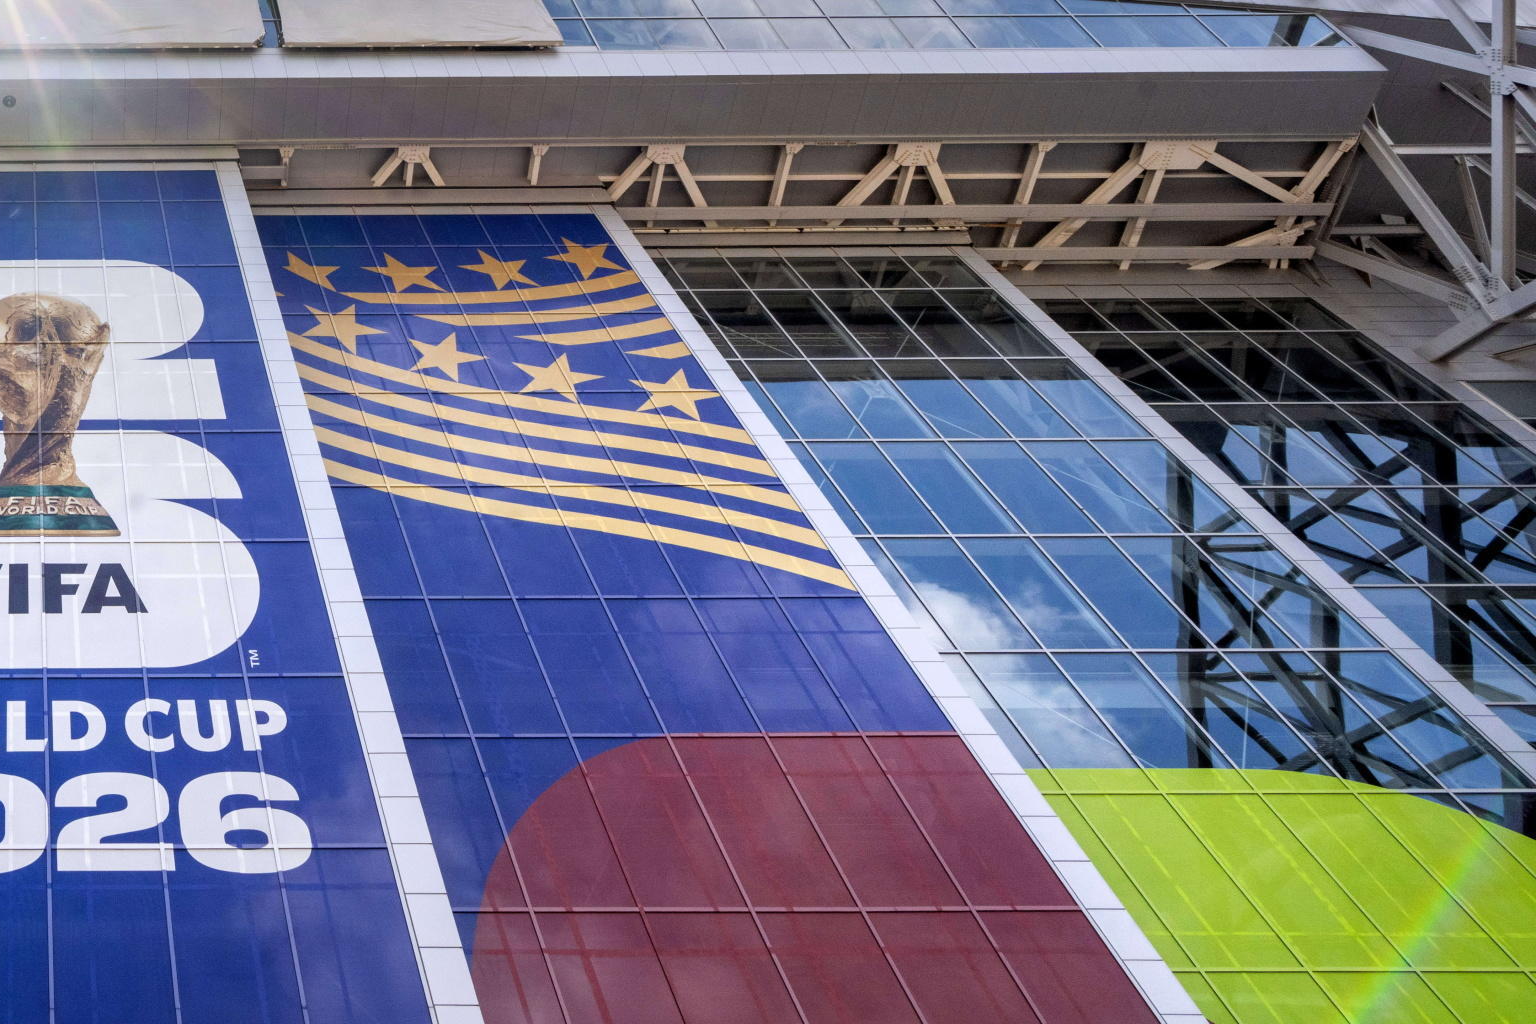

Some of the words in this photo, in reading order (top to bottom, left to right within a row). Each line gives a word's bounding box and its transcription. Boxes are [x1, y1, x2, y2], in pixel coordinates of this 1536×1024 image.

[7, 496, 80, 506] FIFA
[64, 506, 99, 515] CUP
[248, 649, 260, 668] TM
[124, 698, 287, 752] CUP
